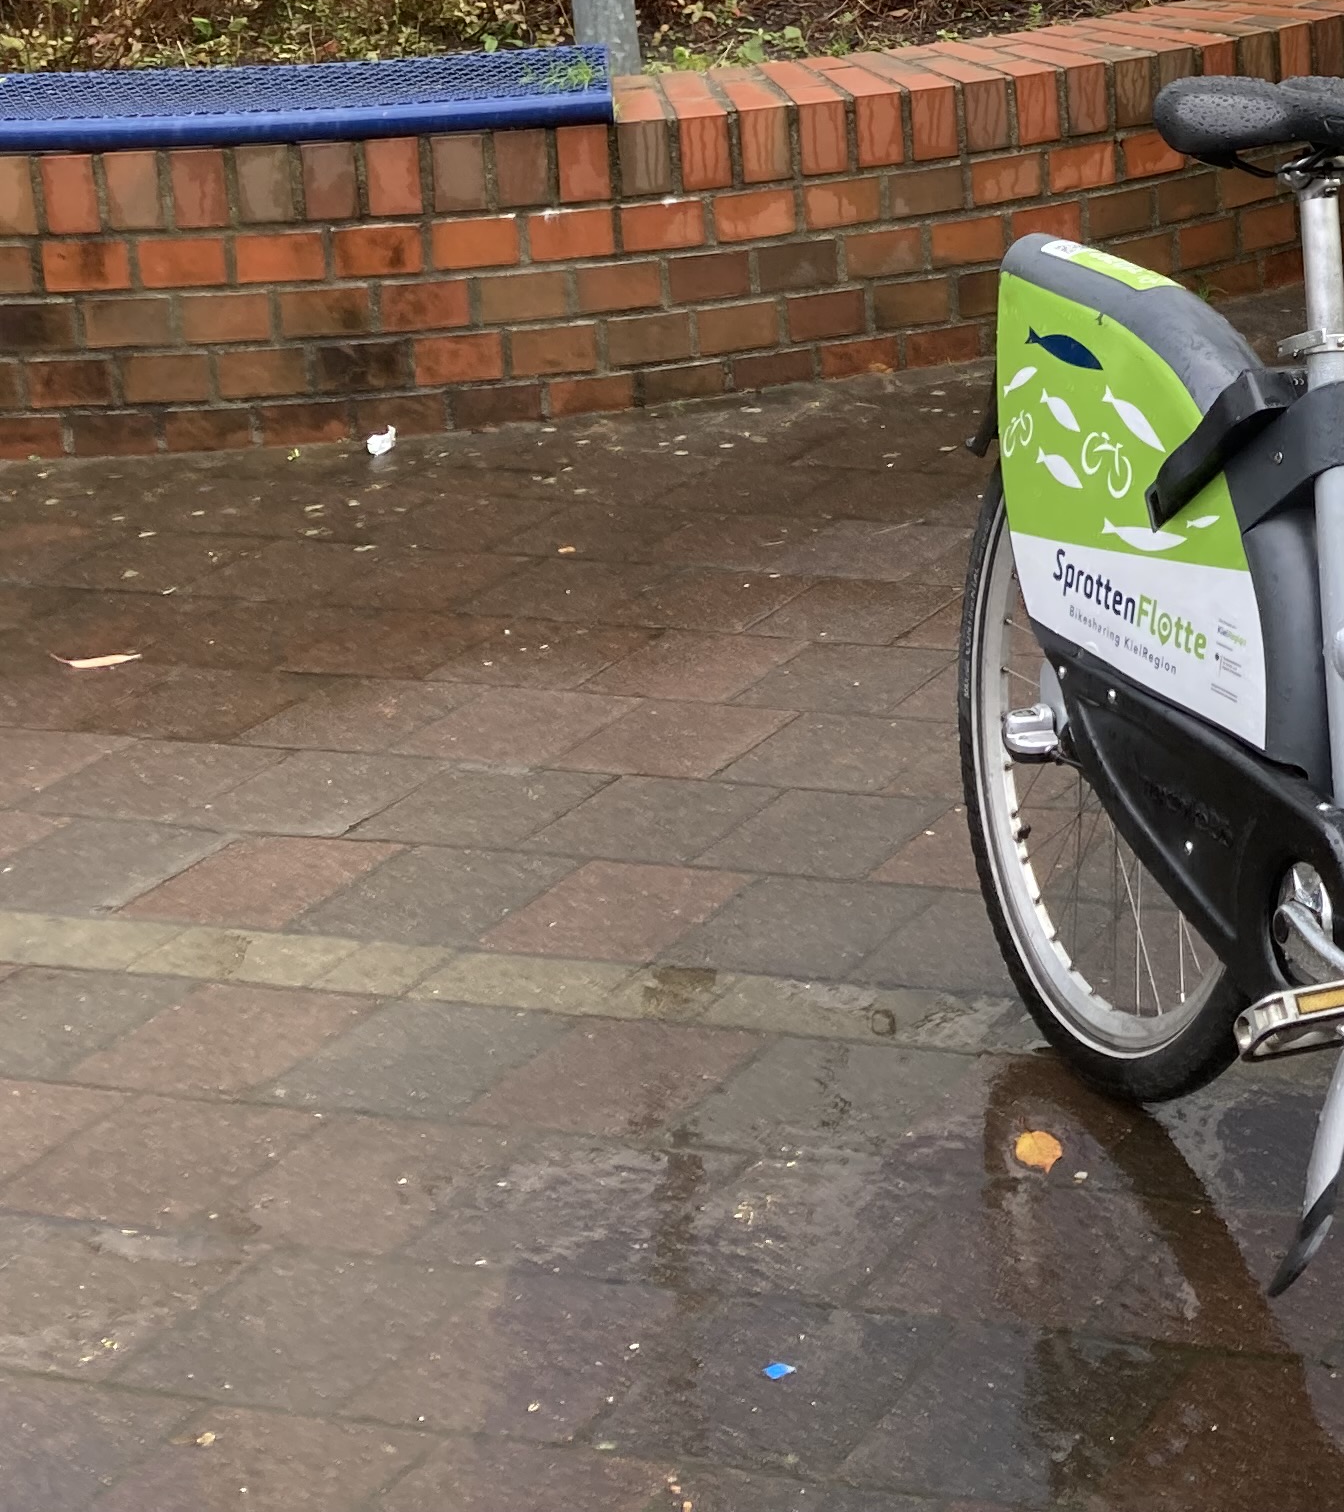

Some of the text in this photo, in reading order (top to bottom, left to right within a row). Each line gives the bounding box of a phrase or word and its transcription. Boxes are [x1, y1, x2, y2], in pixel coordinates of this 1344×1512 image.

[1053, 549, 1207, 660] SprottenFlotte
[1069, 605, 1121, 648] Bikesharing
[1123, 636, 1177, 675] KielRegion
